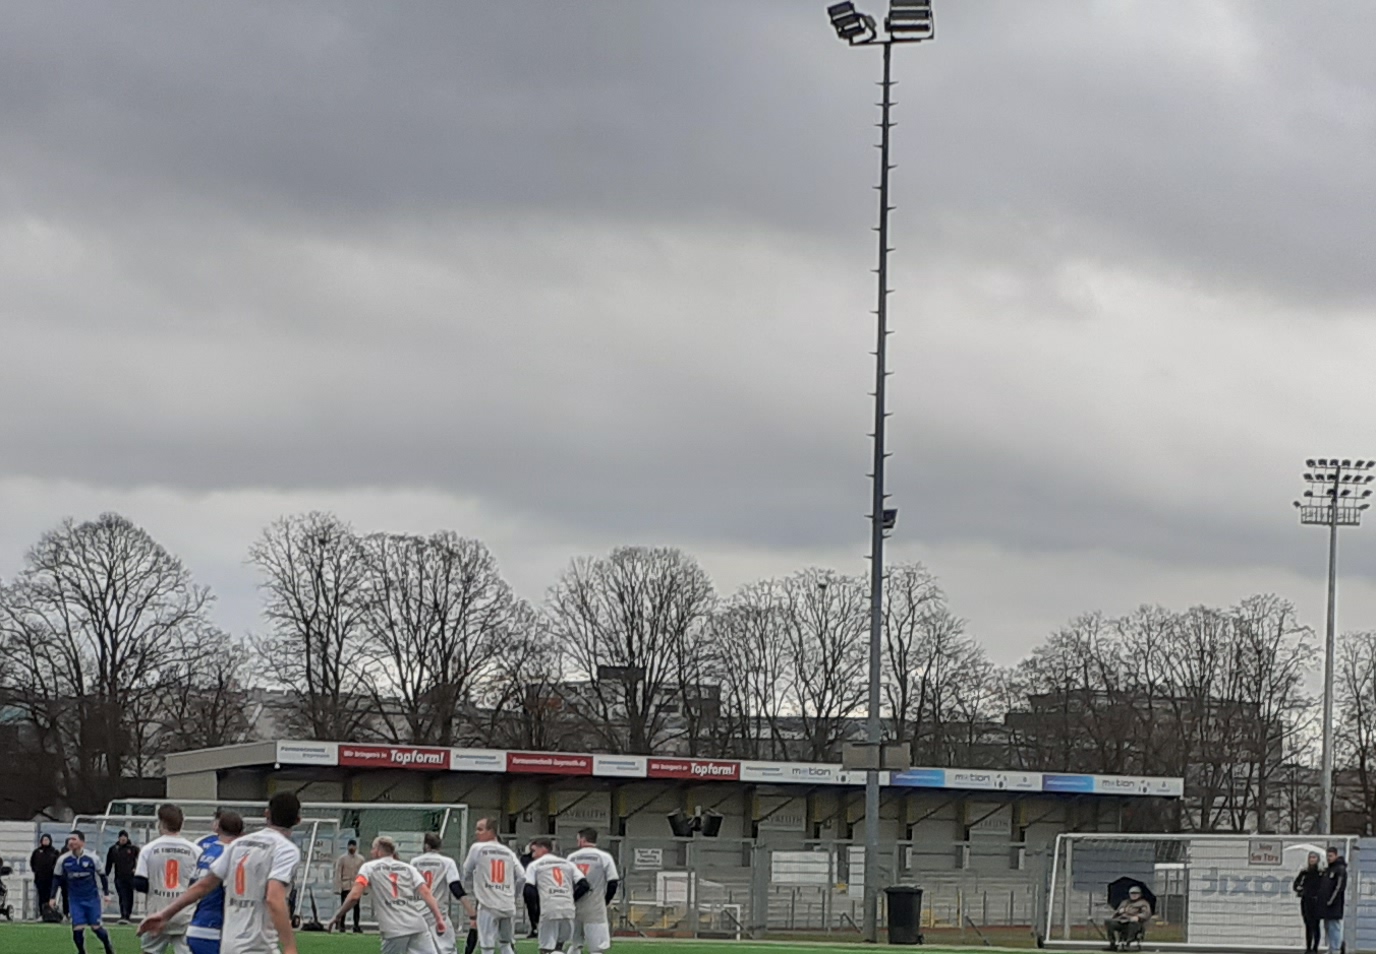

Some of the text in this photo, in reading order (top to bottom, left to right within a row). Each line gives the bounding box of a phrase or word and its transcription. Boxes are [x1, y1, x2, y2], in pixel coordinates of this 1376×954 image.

[390, 749, 445, 766] Topform!
[690, 762, 736, 777] Topform!
[164, 858, 180, 890] 8
[490, 859, 506, 884] 10
